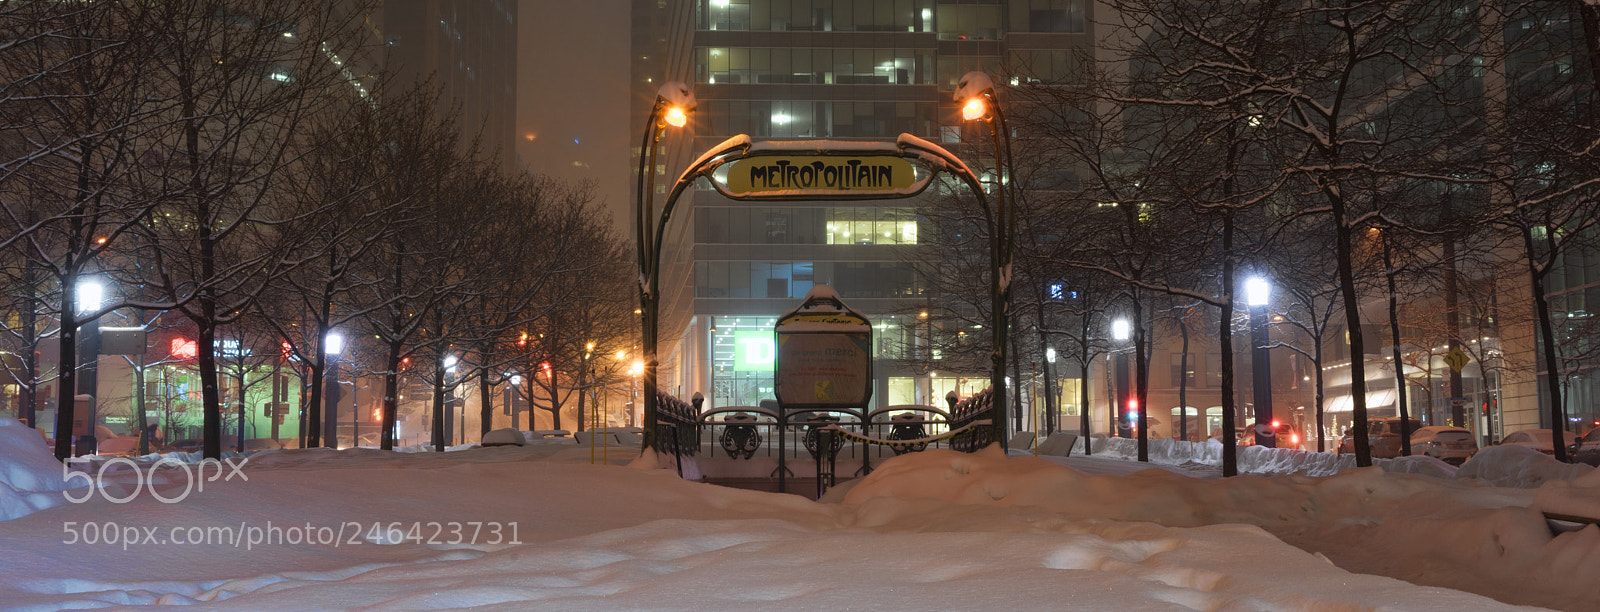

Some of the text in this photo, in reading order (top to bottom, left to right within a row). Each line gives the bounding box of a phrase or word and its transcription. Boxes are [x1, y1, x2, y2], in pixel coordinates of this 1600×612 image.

[750, 160, 892, 190] METROPOLITAIN
[738, 338, 775, 363] TD
[824, 347, 857, 357] merci
